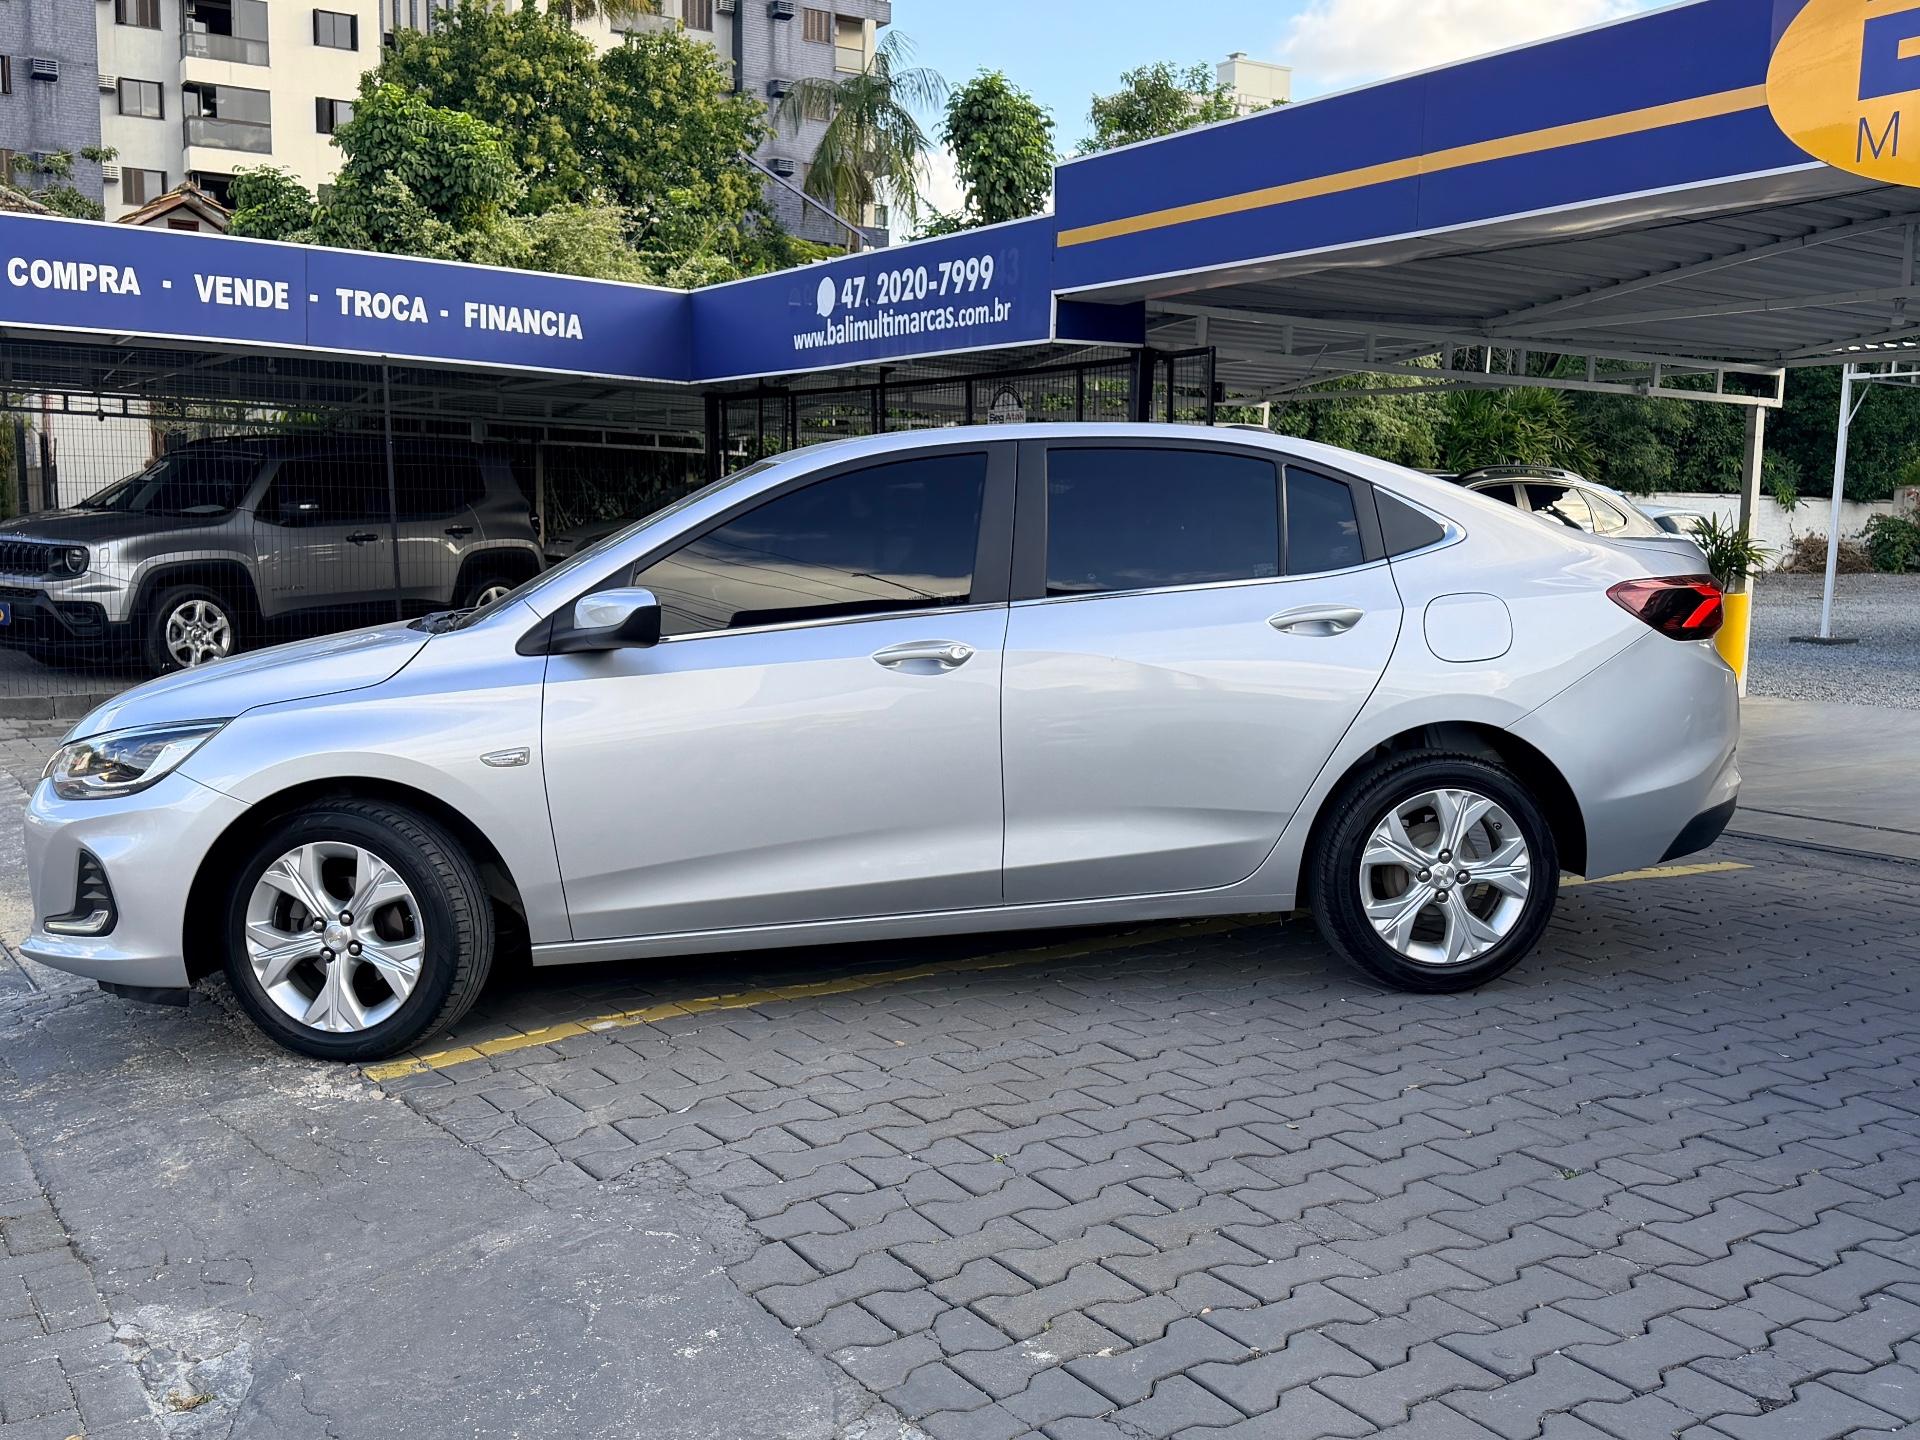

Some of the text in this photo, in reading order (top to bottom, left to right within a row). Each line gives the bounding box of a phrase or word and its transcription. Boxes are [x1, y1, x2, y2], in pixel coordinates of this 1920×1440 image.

[7, 257, 141, 296] COMPRA
[194, 273, 290, 310] VENDE
[335, 287, 429, 324] TROCA
[464, 301, 583, 340] FINANCIA
[877, 255, 994, 305] 2020-7999
[793, 296, 1012, 350] www.balimultimarcas.com.br
